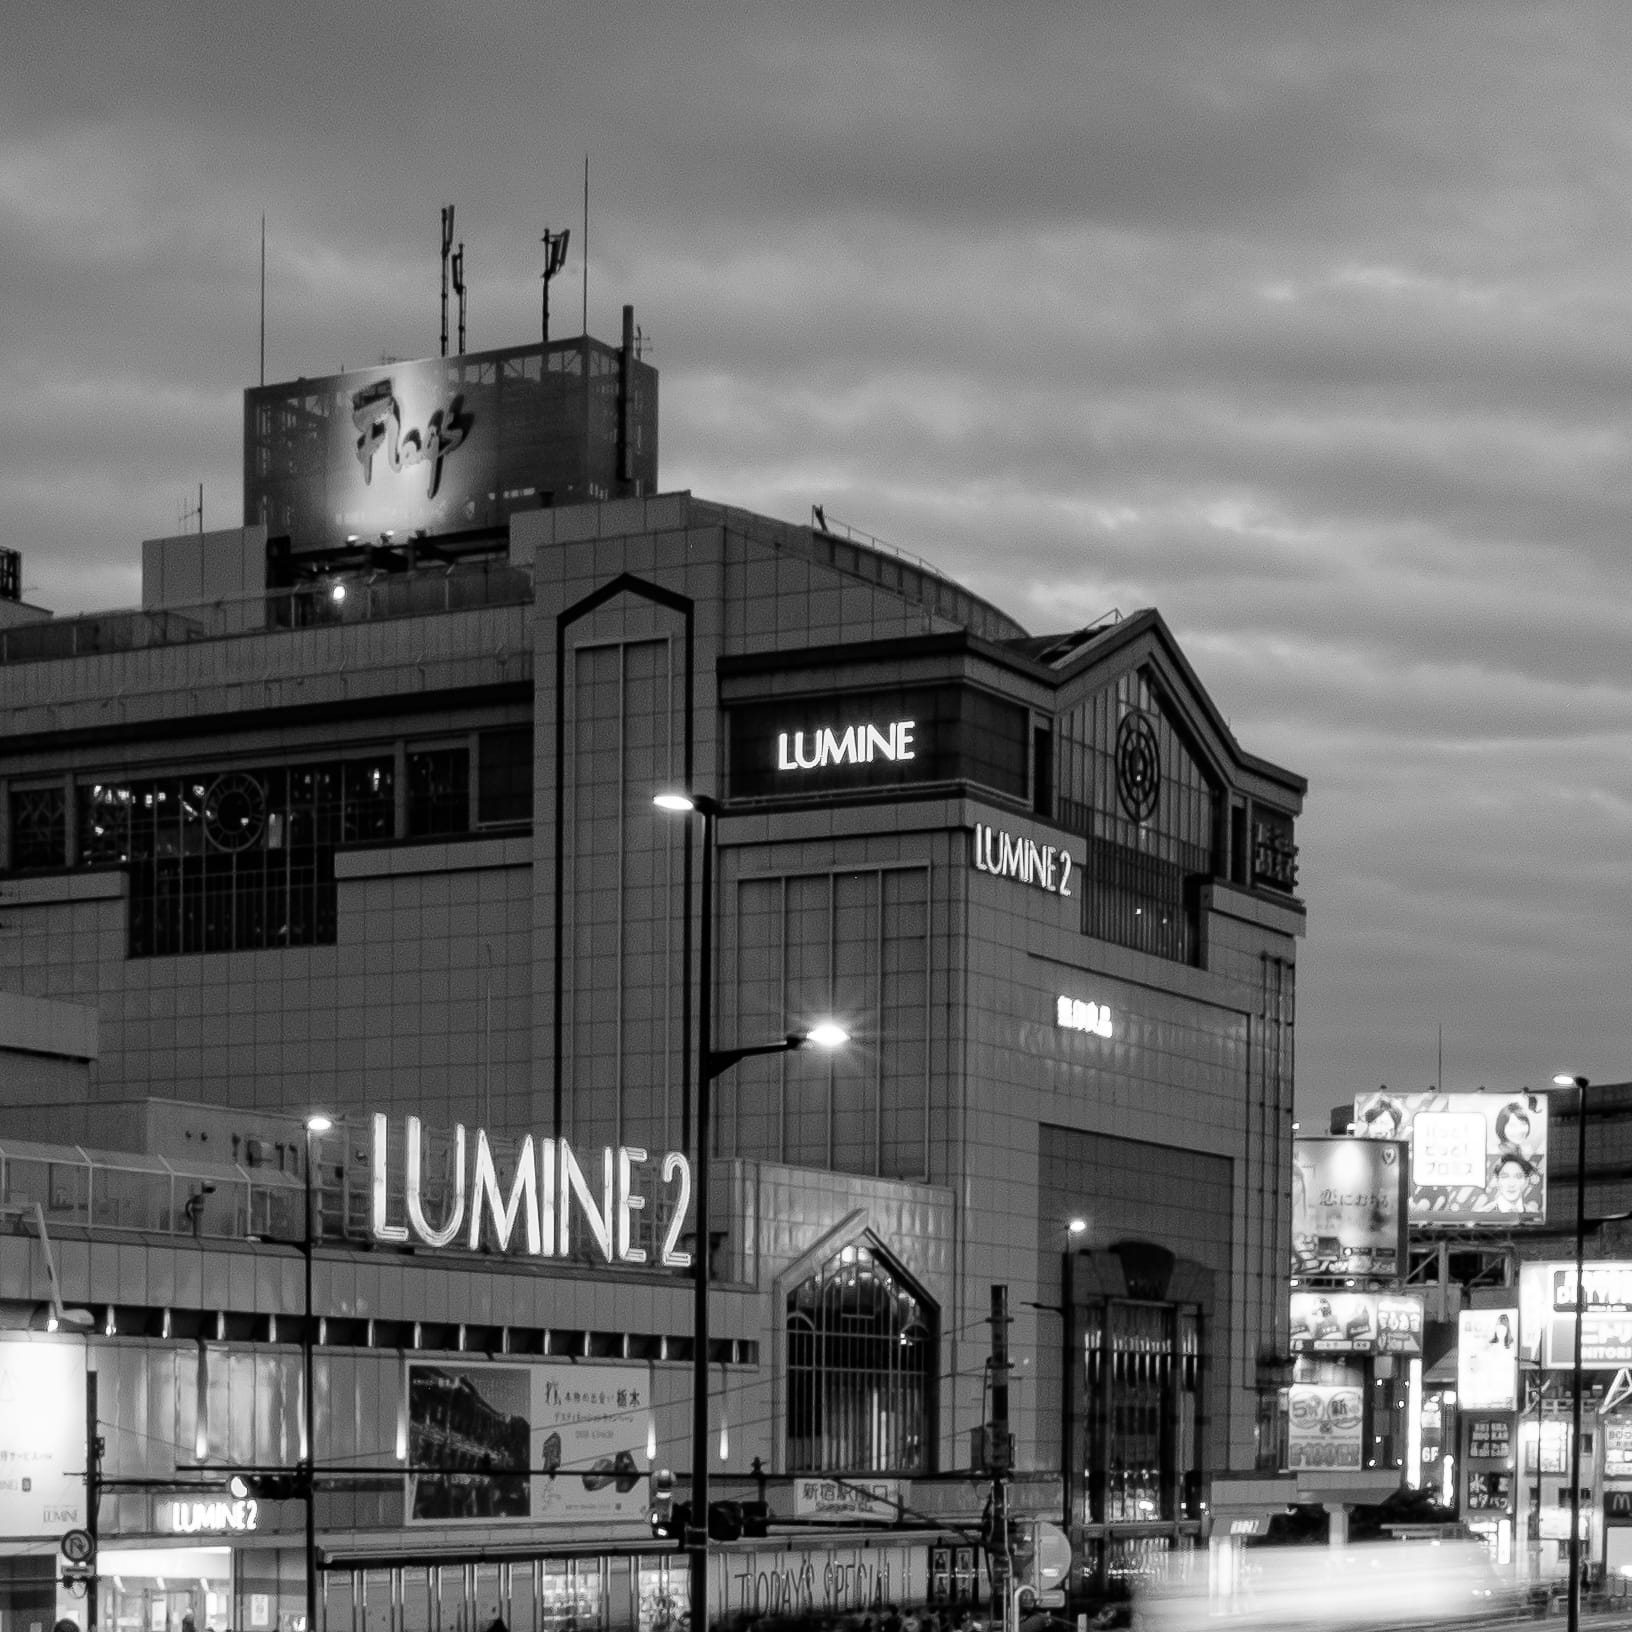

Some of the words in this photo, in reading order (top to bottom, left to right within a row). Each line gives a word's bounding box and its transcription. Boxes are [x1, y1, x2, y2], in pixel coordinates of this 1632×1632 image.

[777, 719, 916, 772] LUMINE
[973, 821, 1058, 893] LUMINE
[1058, 849, 1072, 897] 2
[371, 1112, 648, 1264] LUMINE
[661, 1150, 693, 1267] 2
[172, 1501, 246, 1533] LUMINE
